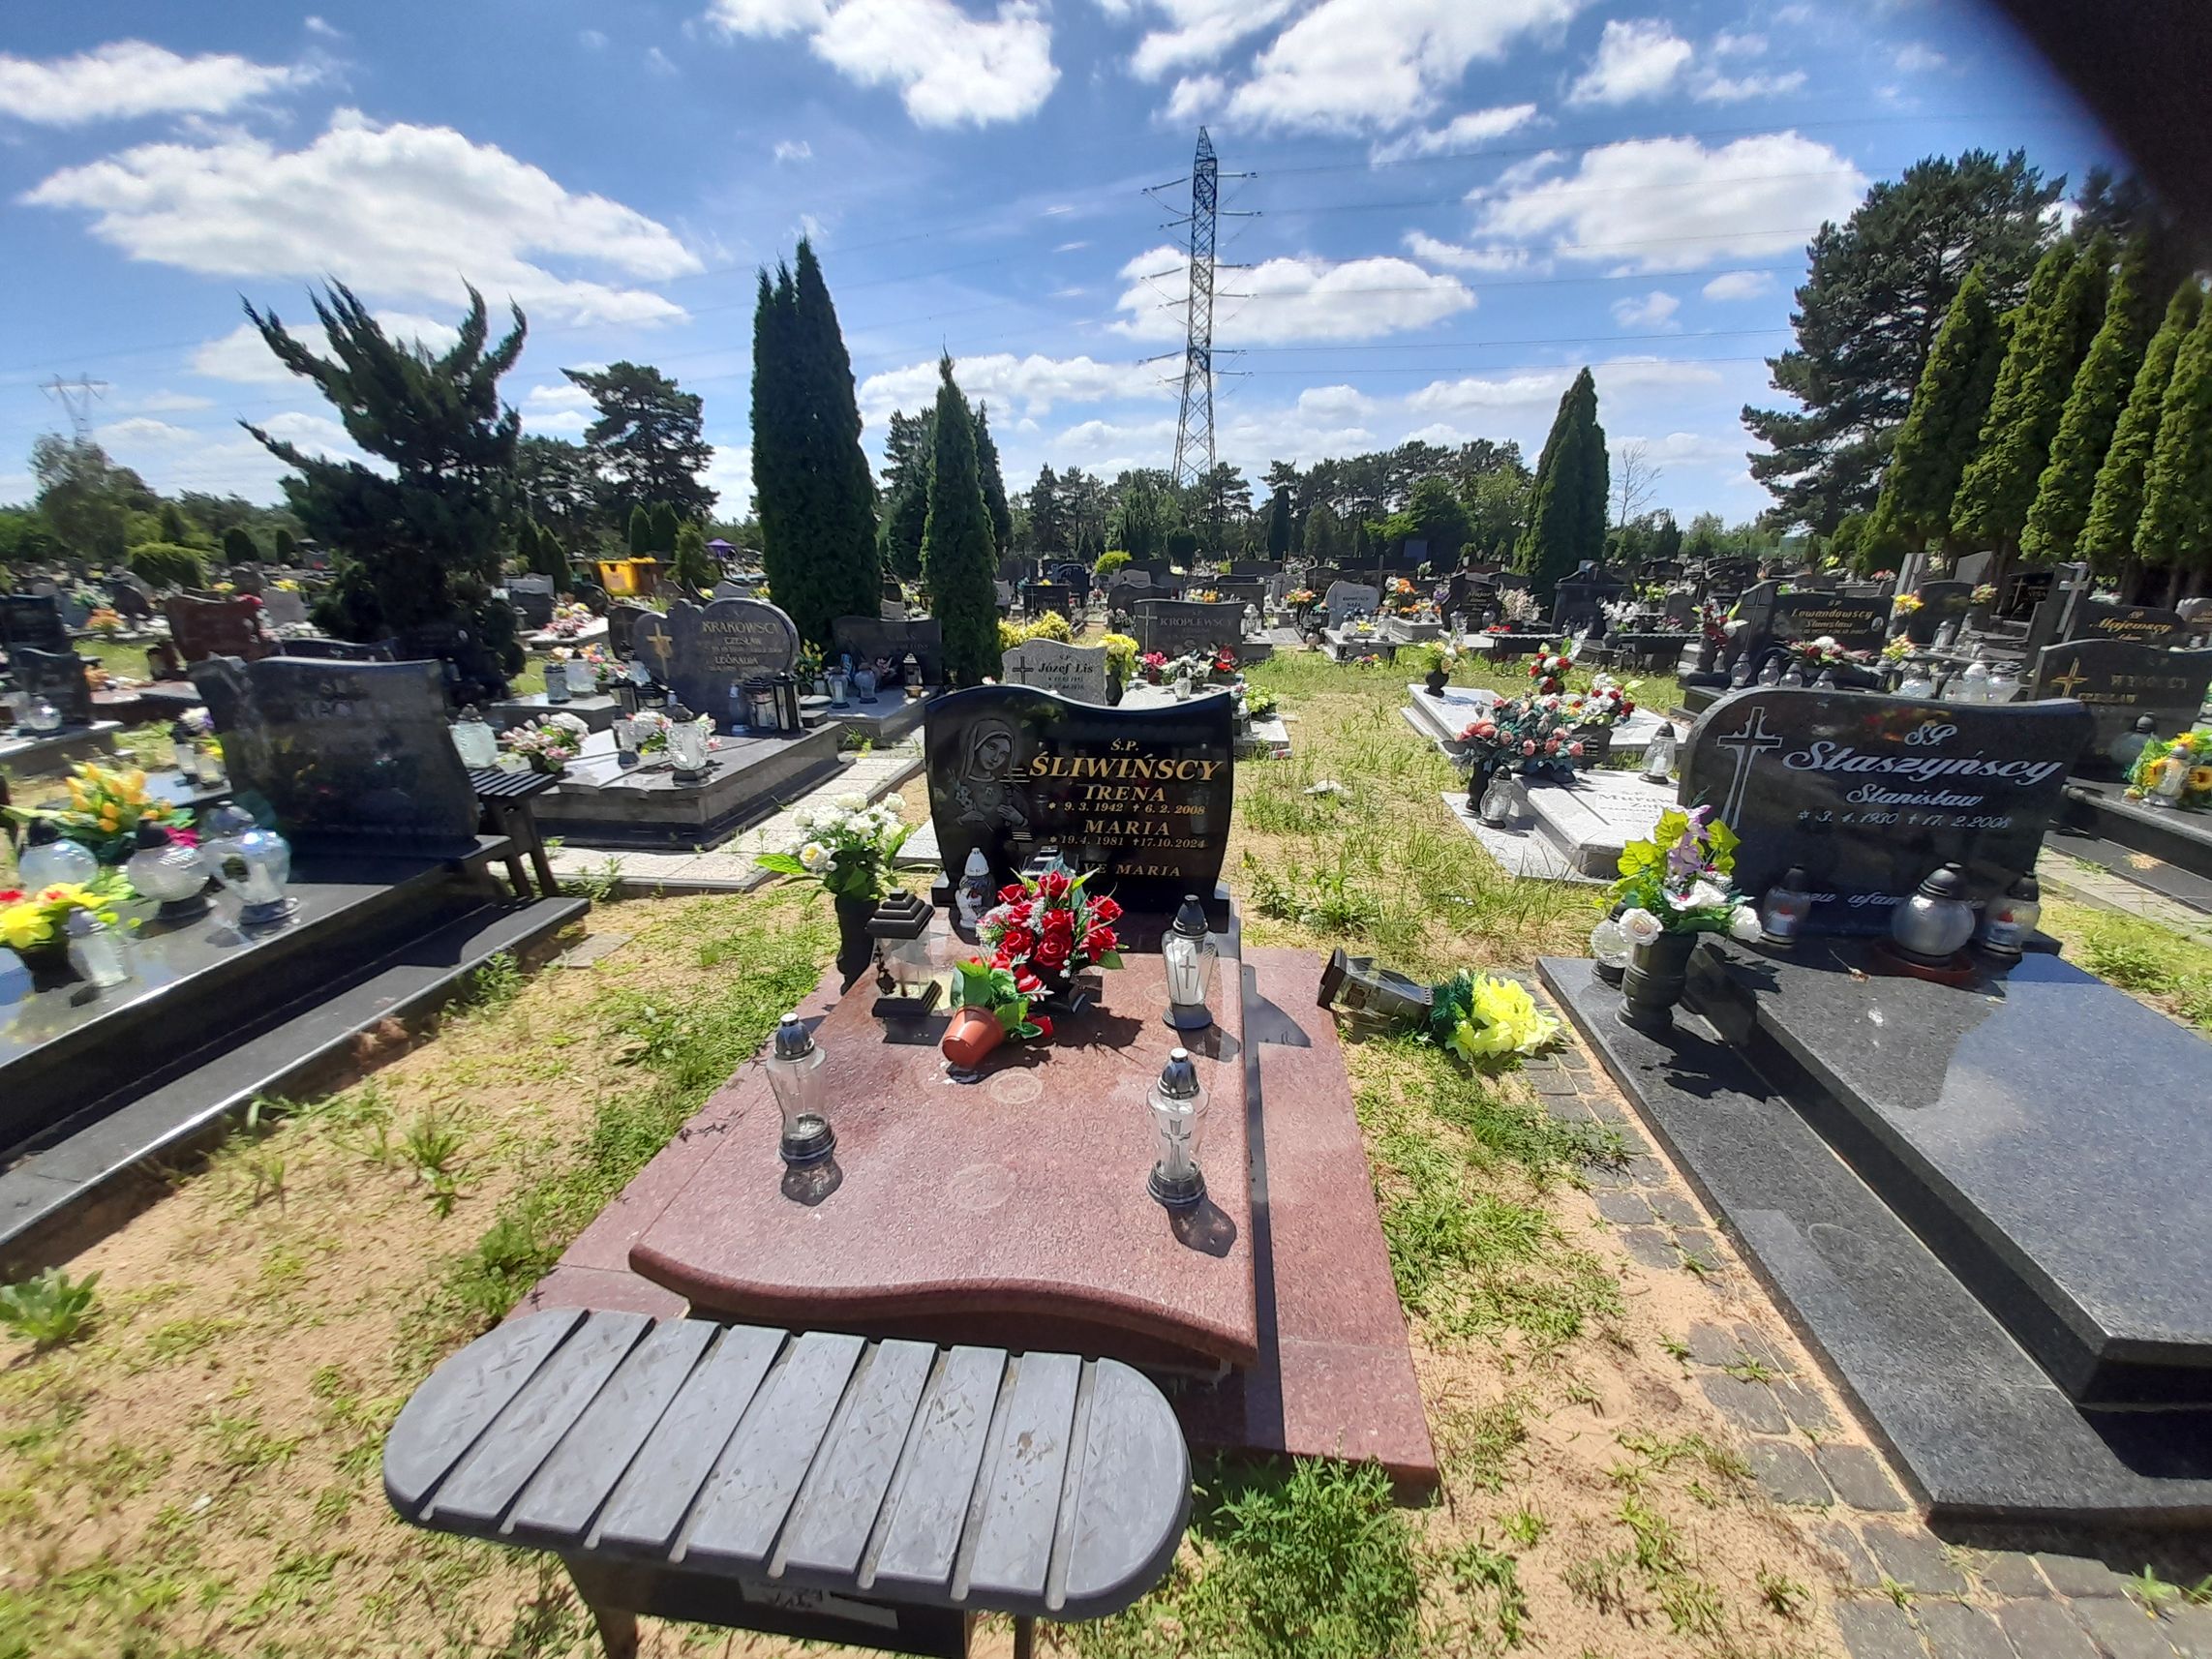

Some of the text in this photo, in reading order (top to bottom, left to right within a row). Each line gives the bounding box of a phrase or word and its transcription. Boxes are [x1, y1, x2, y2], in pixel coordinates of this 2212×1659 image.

[1038, 662, 1093, 675] Józef Lis
[1029, 751, 1224, 781] ŚLIWIŃSCY
[1782, 740, 2063, 786] Staszyńscy
[1084, 785, 1166, 801] IRENA
[1095, 802, 1124, 812] 1942
[1173, 805, 1206, 815] 2008
[1083, 819, 1170, 836] MARIA
[1097, 836, 1124, 846] 1981
[1114, 863, 1182, 877] MARIA
